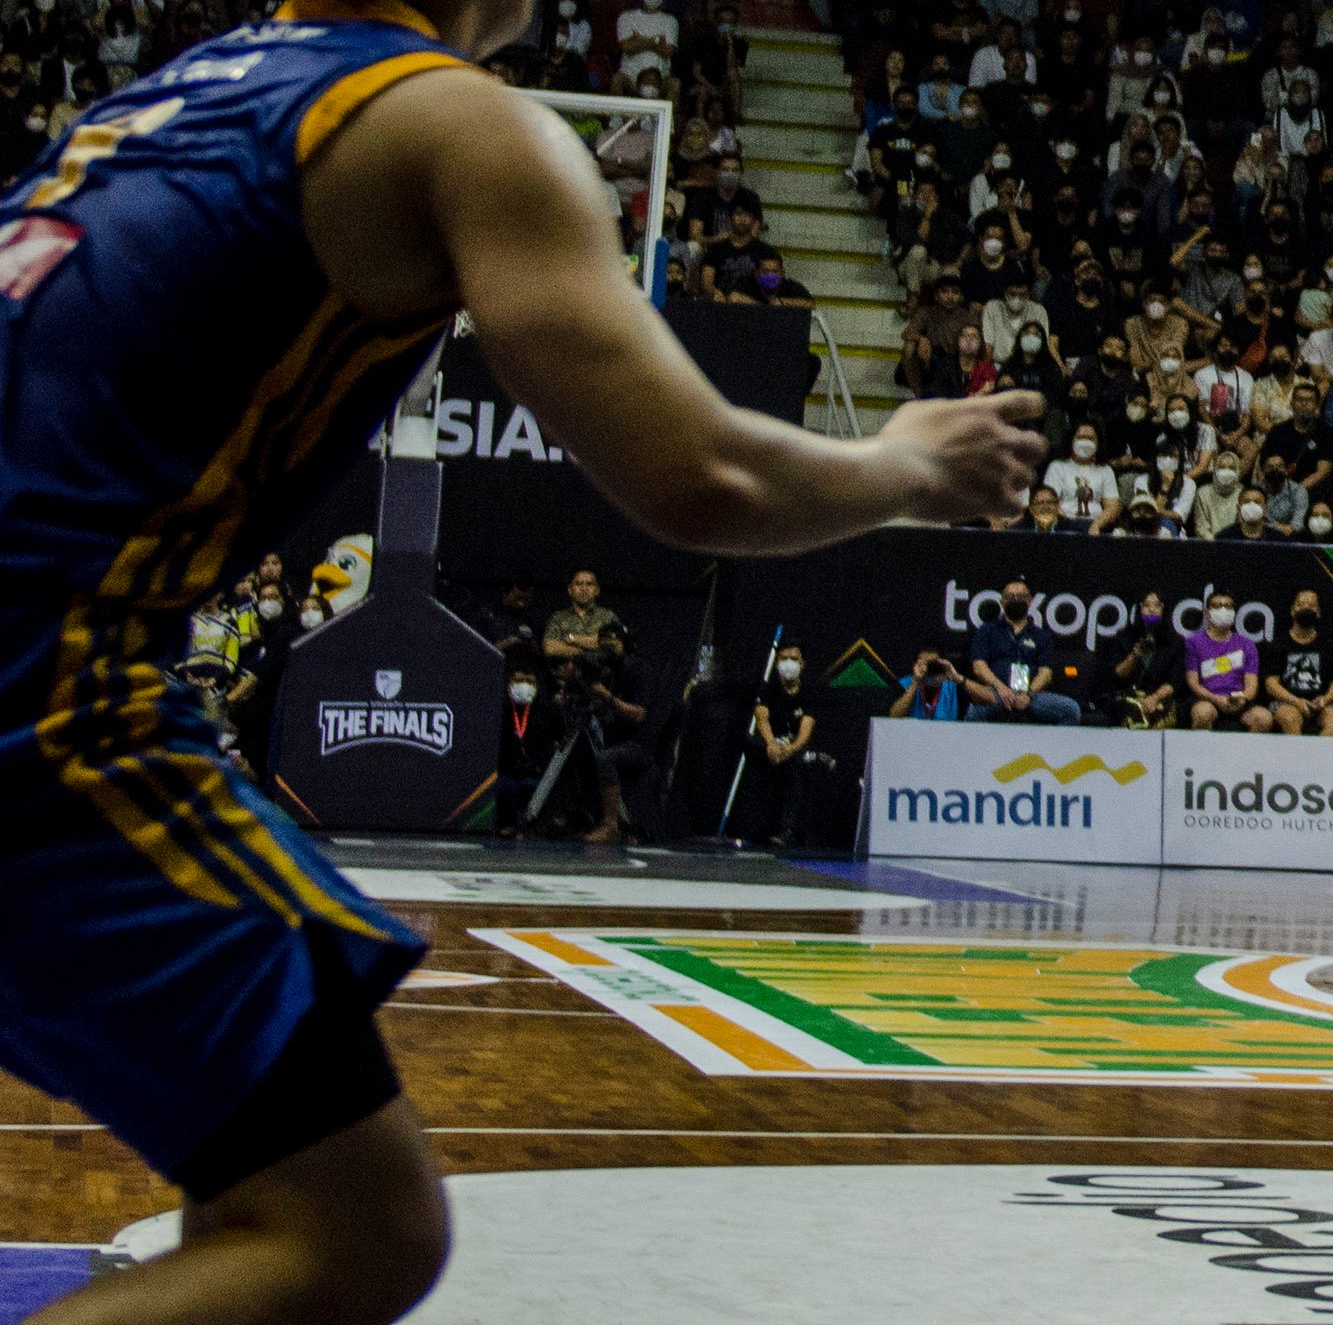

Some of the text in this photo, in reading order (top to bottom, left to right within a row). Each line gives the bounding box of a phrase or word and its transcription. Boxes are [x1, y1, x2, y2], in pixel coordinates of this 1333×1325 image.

[324, 709, 449, 748] THE FINALS
[888, 780, 1092, 828] mandiri
[1183, 814, 1273, 830] OOREDOO
